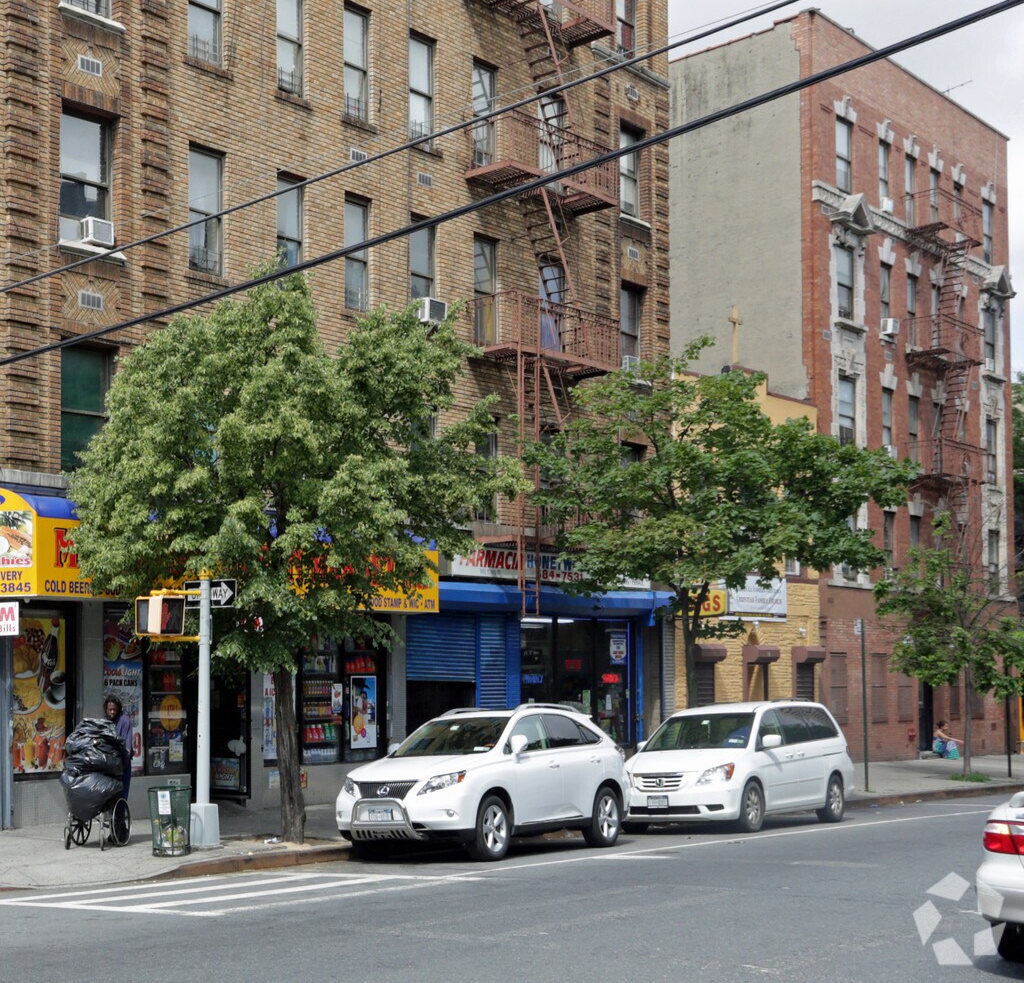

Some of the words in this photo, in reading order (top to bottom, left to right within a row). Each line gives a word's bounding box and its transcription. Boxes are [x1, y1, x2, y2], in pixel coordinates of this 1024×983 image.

[45, 579, 66, 593] COLD
[212, 588, 228, 599] WAY
[383, 597, 402, 609] STAMP
[424, 599, 435, 609] ATM
[109, 678, 124, 687] PACK
[124, 678, 138, 687] CANS
